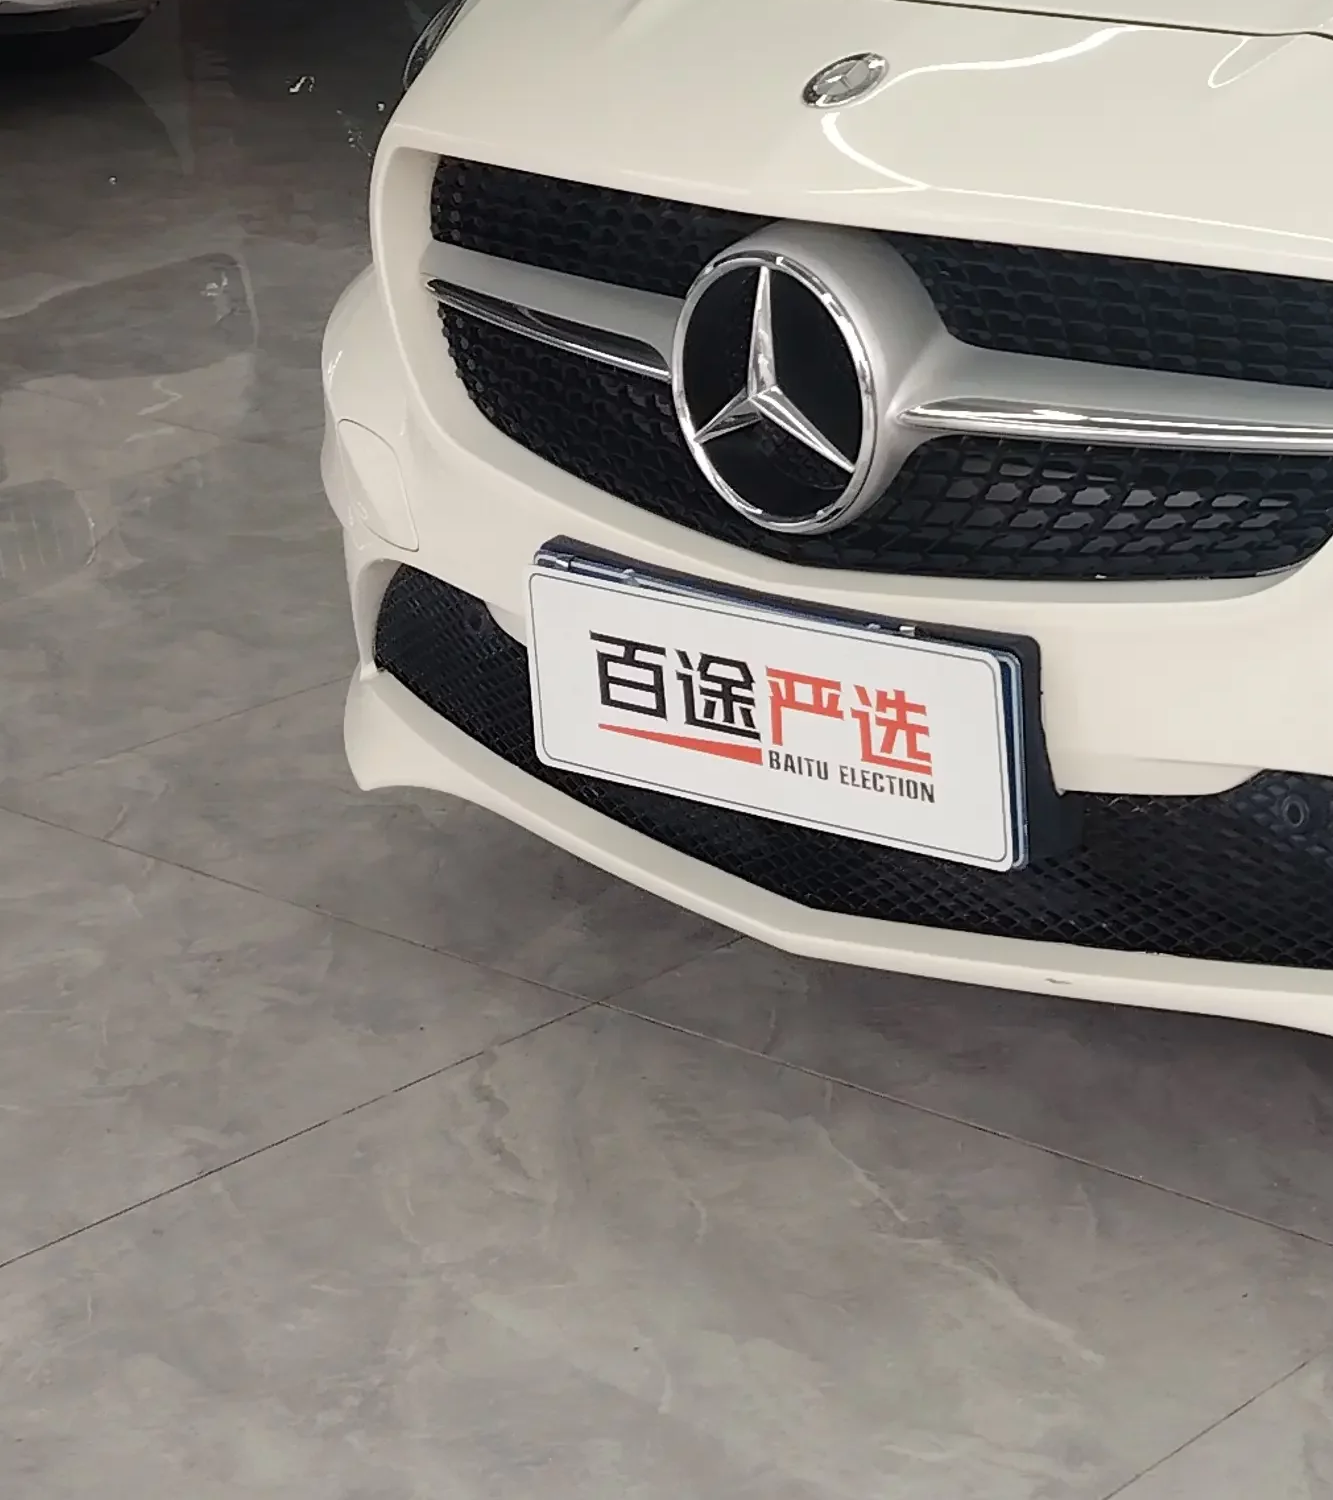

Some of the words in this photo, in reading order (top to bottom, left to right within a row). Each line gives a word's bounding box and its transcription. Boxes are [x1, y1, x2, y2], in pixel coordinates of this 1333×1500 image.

[589, 630, 933, 776] 百途严选
[768, 750, 829, 781] BAITU
[840, 765, 936, 804] ELECTION
